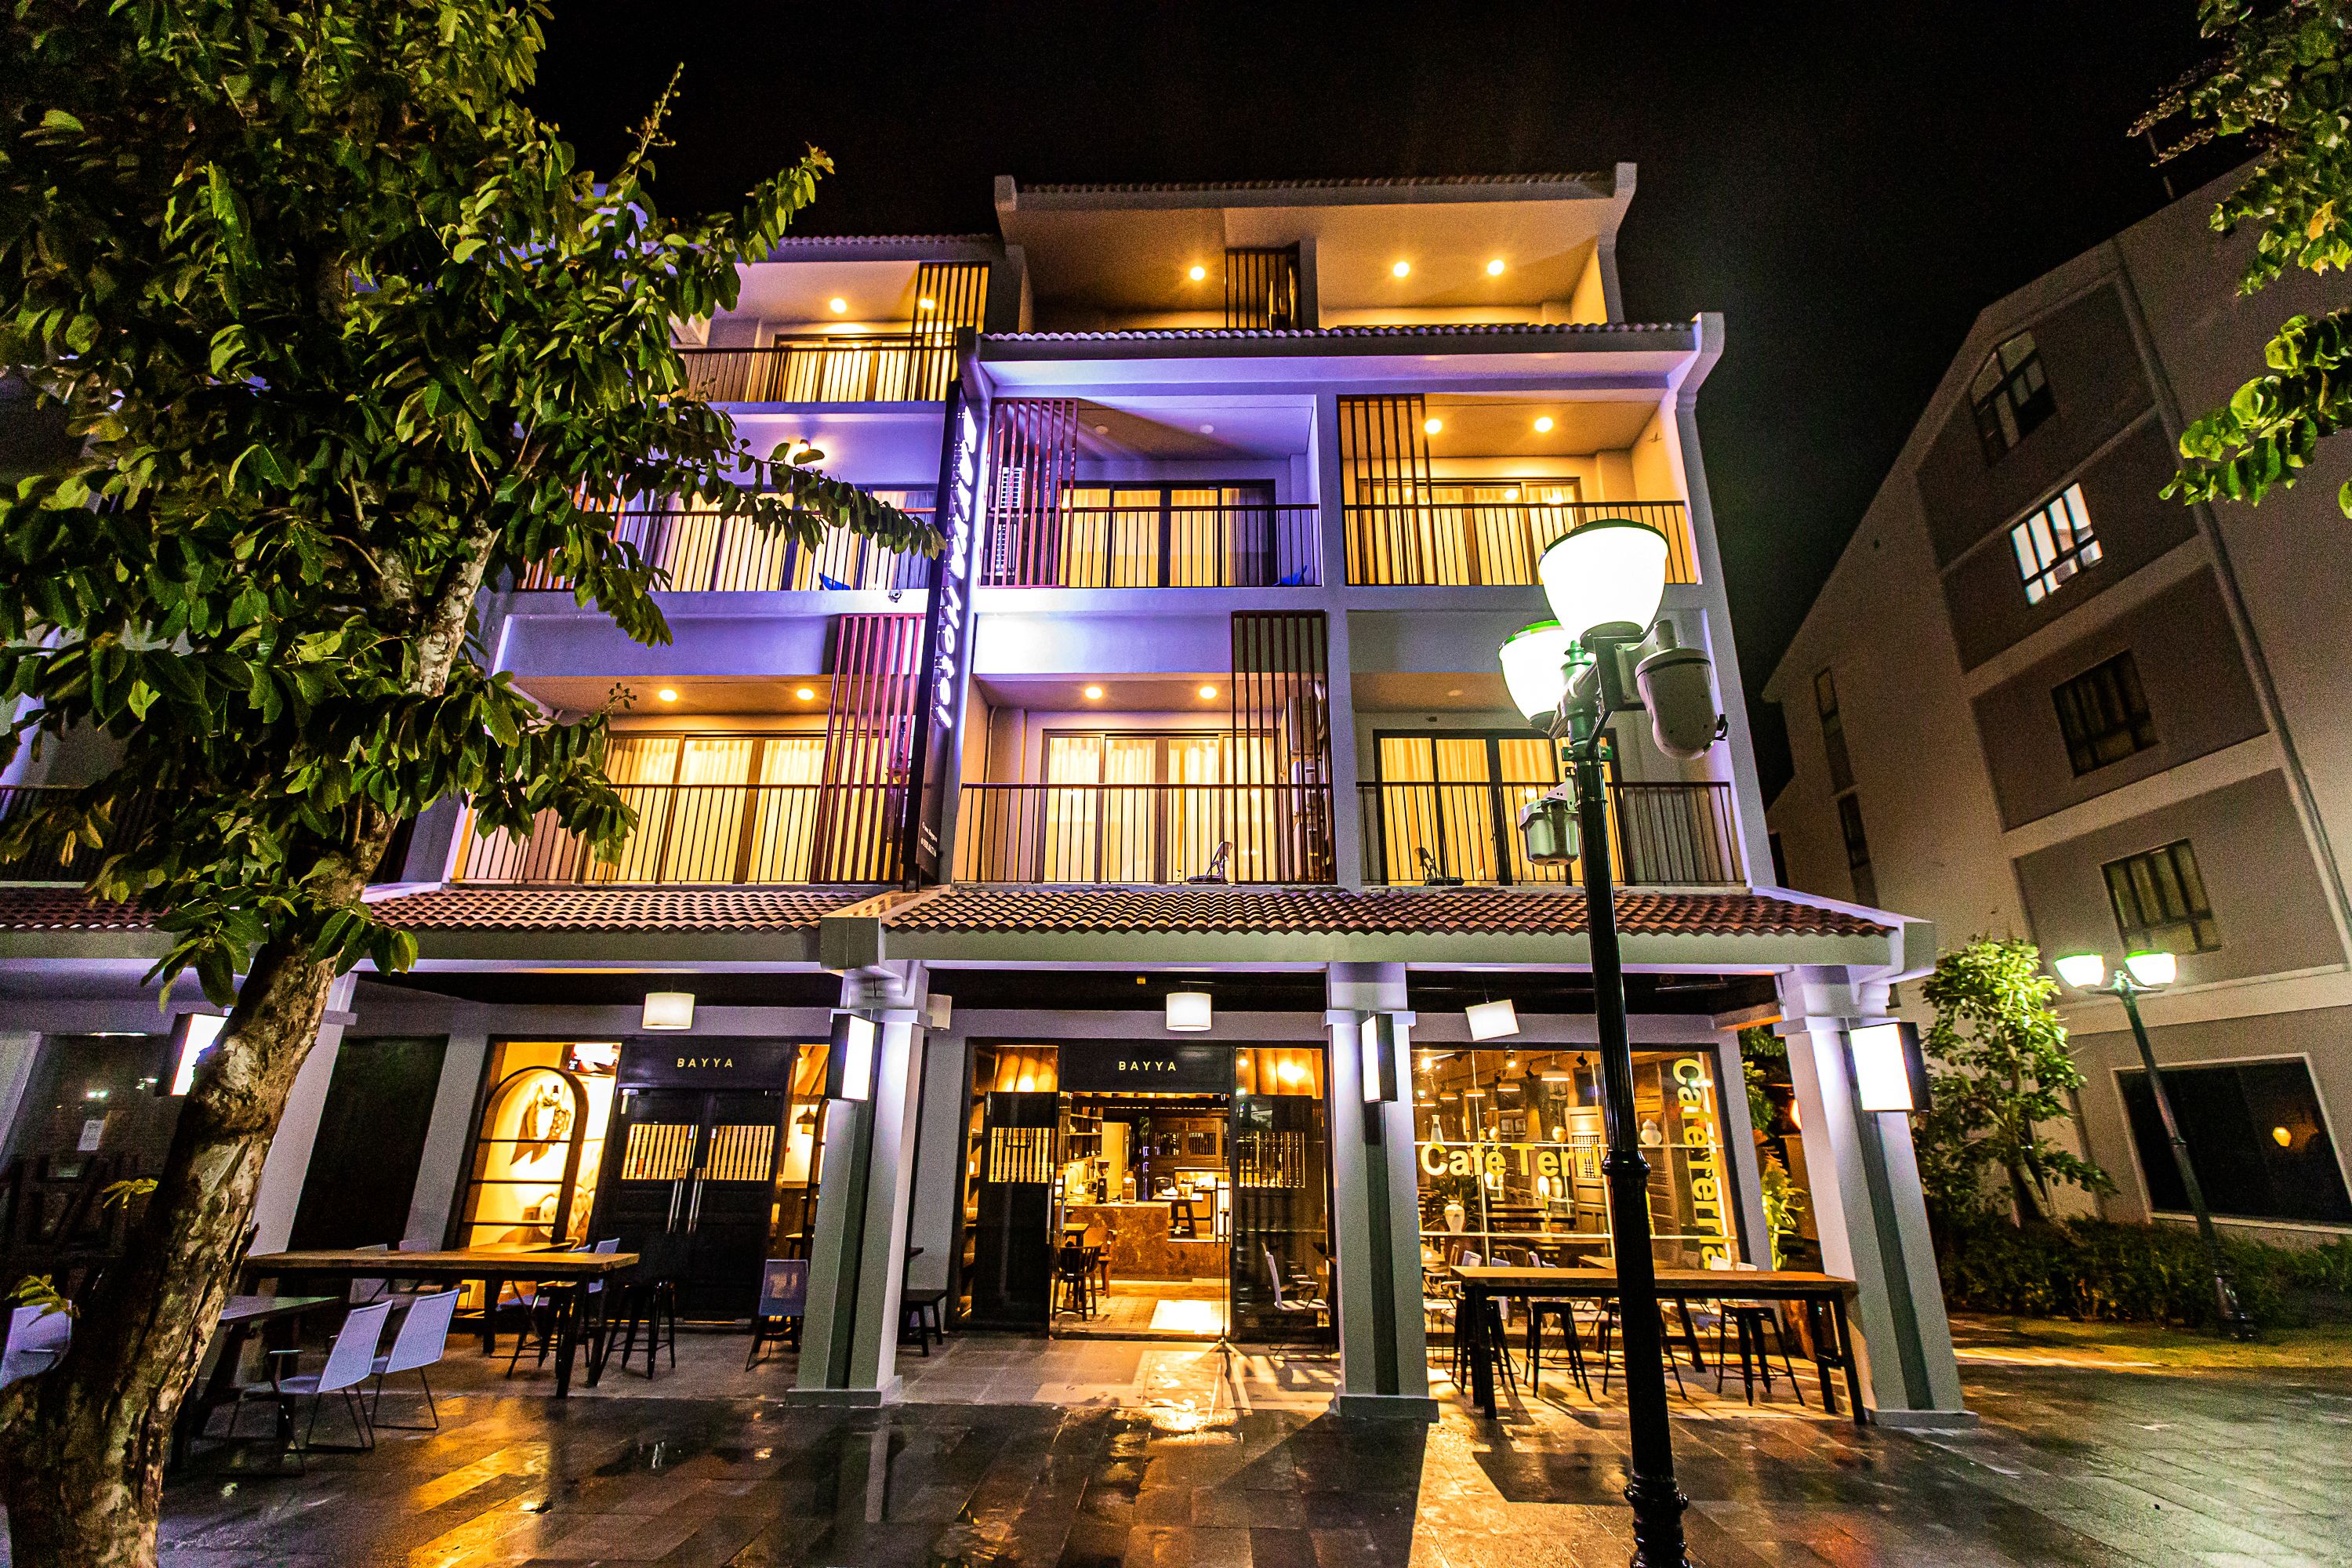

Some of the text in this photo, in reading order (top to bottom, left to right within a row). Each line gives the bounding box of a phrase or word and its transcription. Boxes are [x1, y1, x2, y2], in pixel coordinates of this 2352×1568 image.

[935, 585, 962, 729] Hotel
[677, 1058, 733, 1068] BAYYA
[1118, 1061, 1177, 1071] BAYYA
[1420, 1142, 1602, 1177] Café Terri
